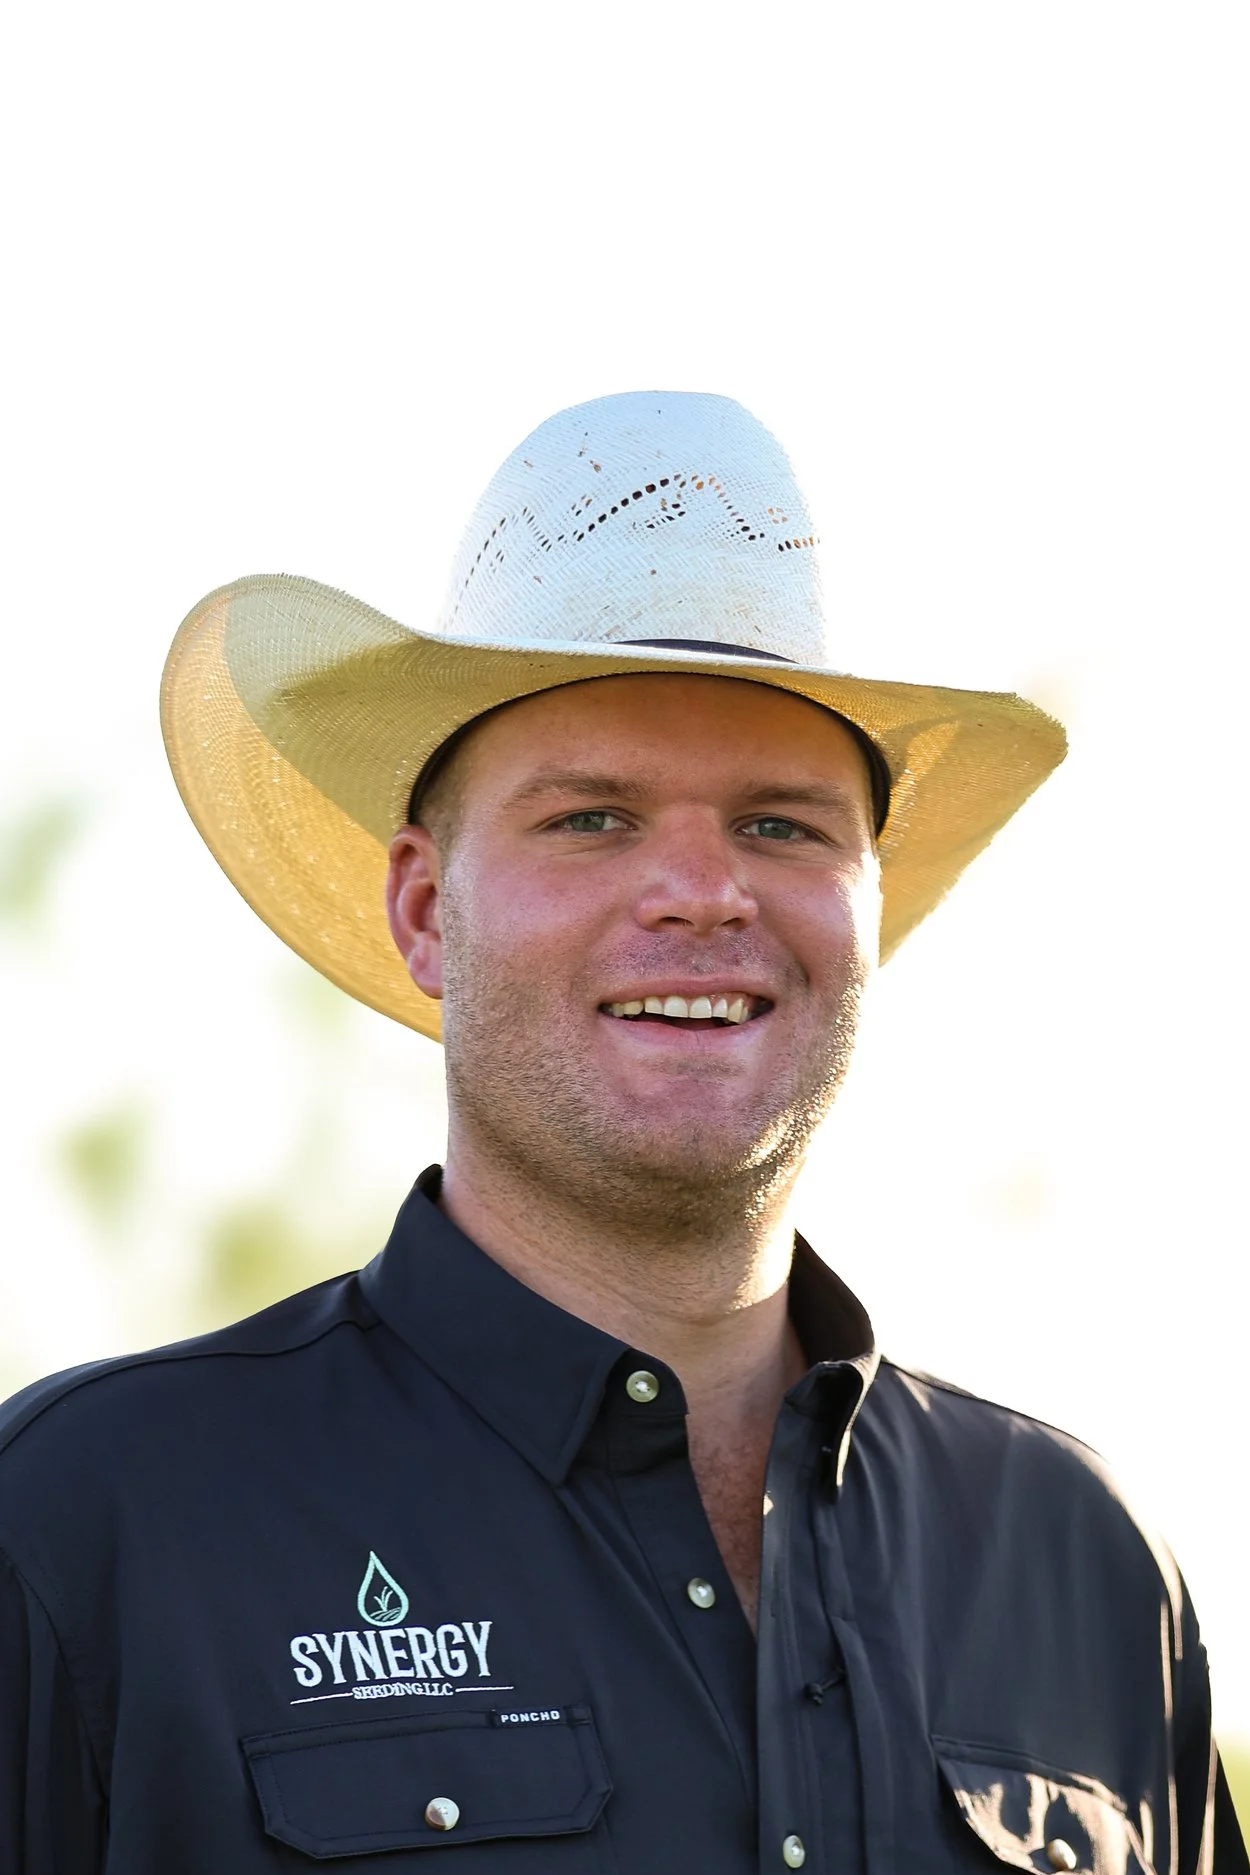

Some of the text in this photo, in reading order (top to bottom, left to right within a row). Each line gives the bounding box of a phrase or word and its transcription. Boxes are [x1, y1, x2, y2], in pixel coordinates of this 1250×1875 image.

[290, 1621, 492, 1687] SYNERGY
[351, 1682, 424, 1700] SEEDING
[501, 1710, 560, 1723] PONCHO
